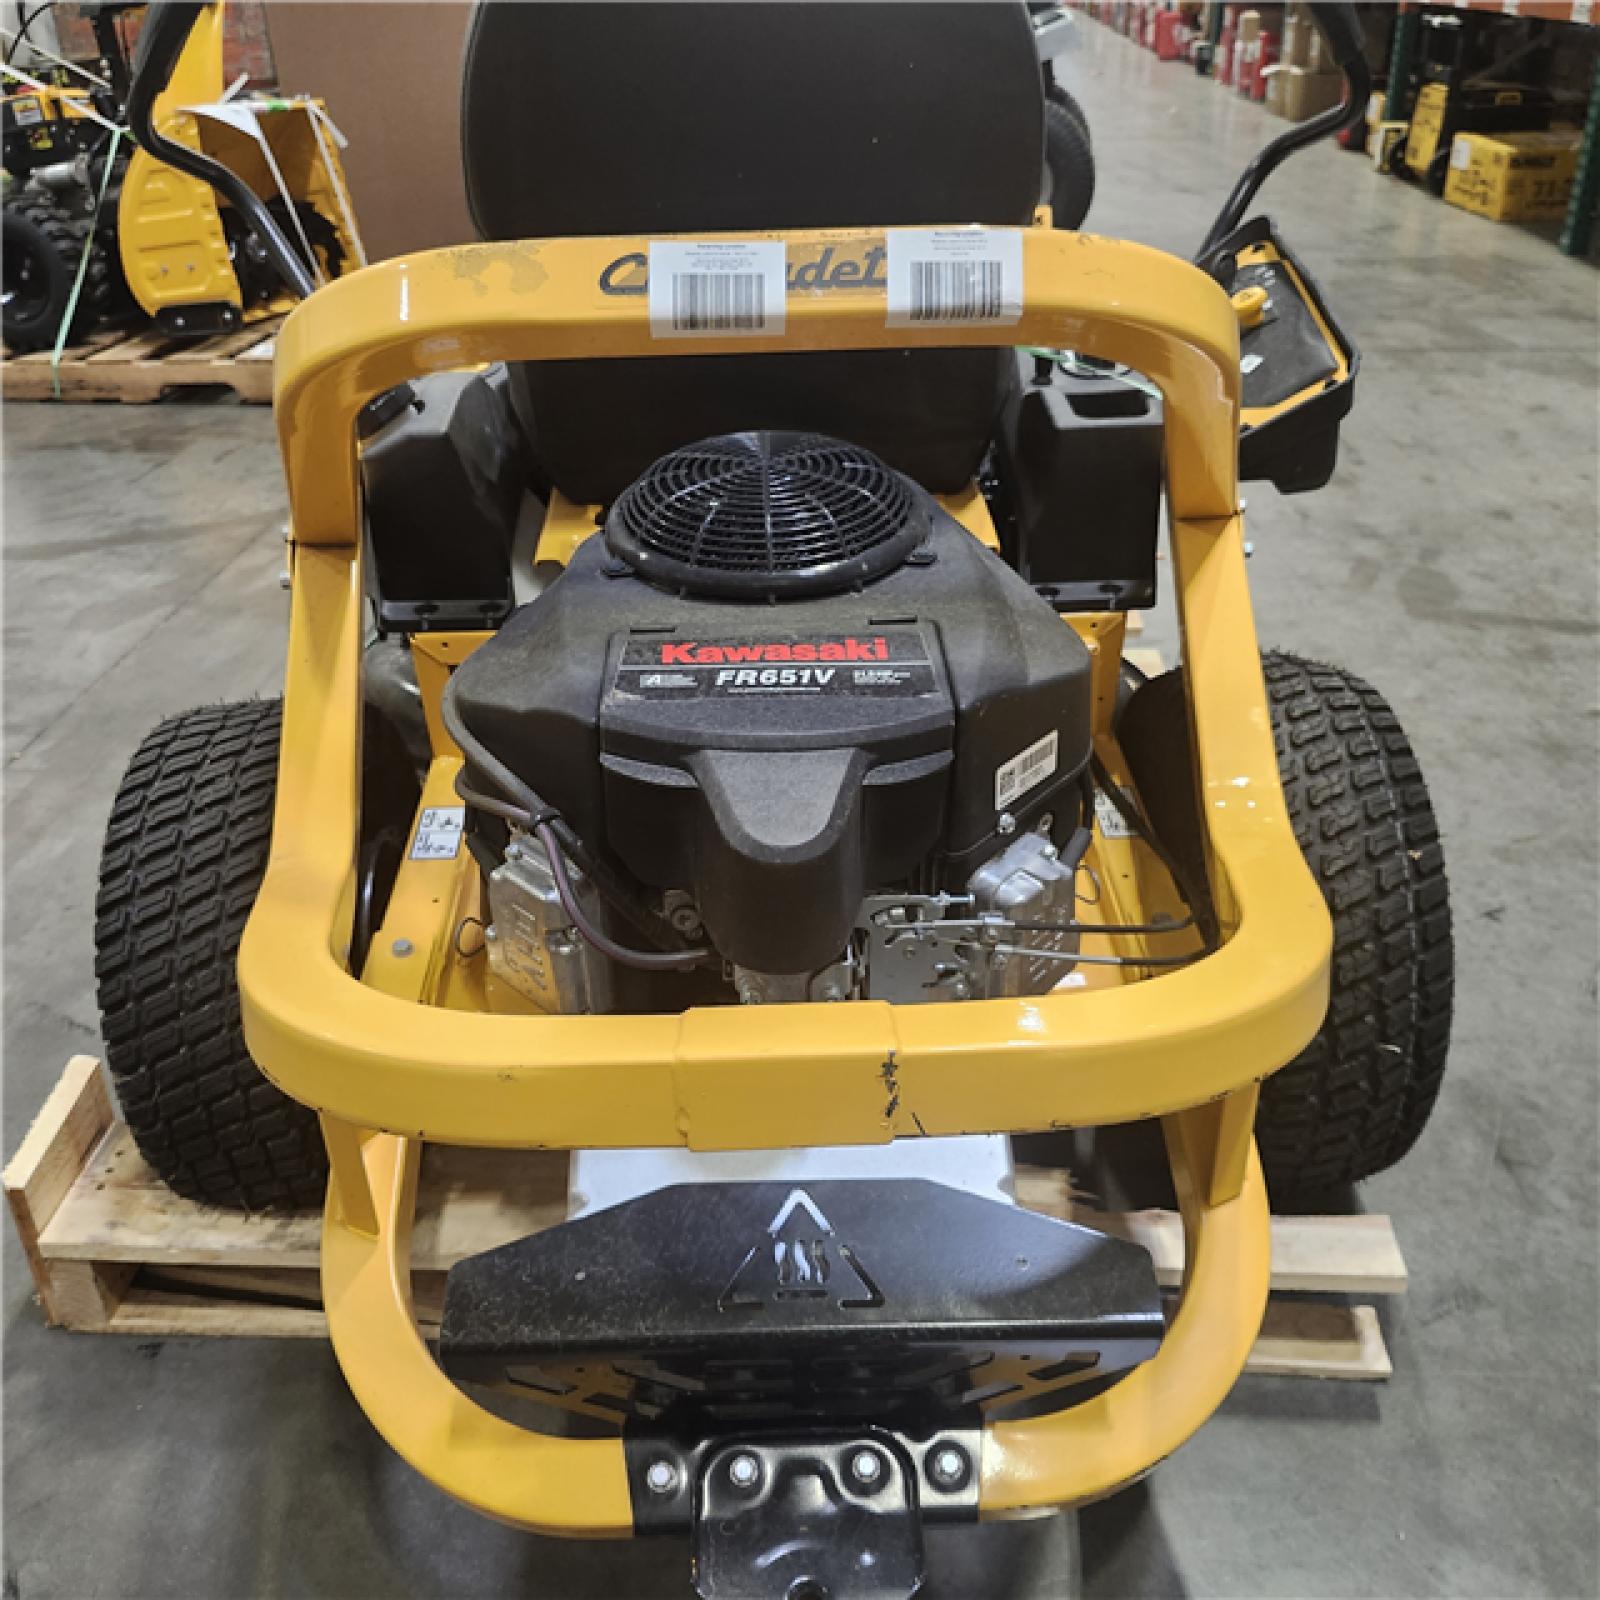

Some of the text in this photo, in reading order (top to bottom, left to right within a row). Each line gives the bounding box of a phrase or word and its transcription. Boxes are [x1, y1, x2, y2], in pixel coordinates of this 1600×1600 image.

[786, 246, 887, 290] det
[661, 638, 888, 663] Kawasaki
[716, 669, 835, 686] FR651V
